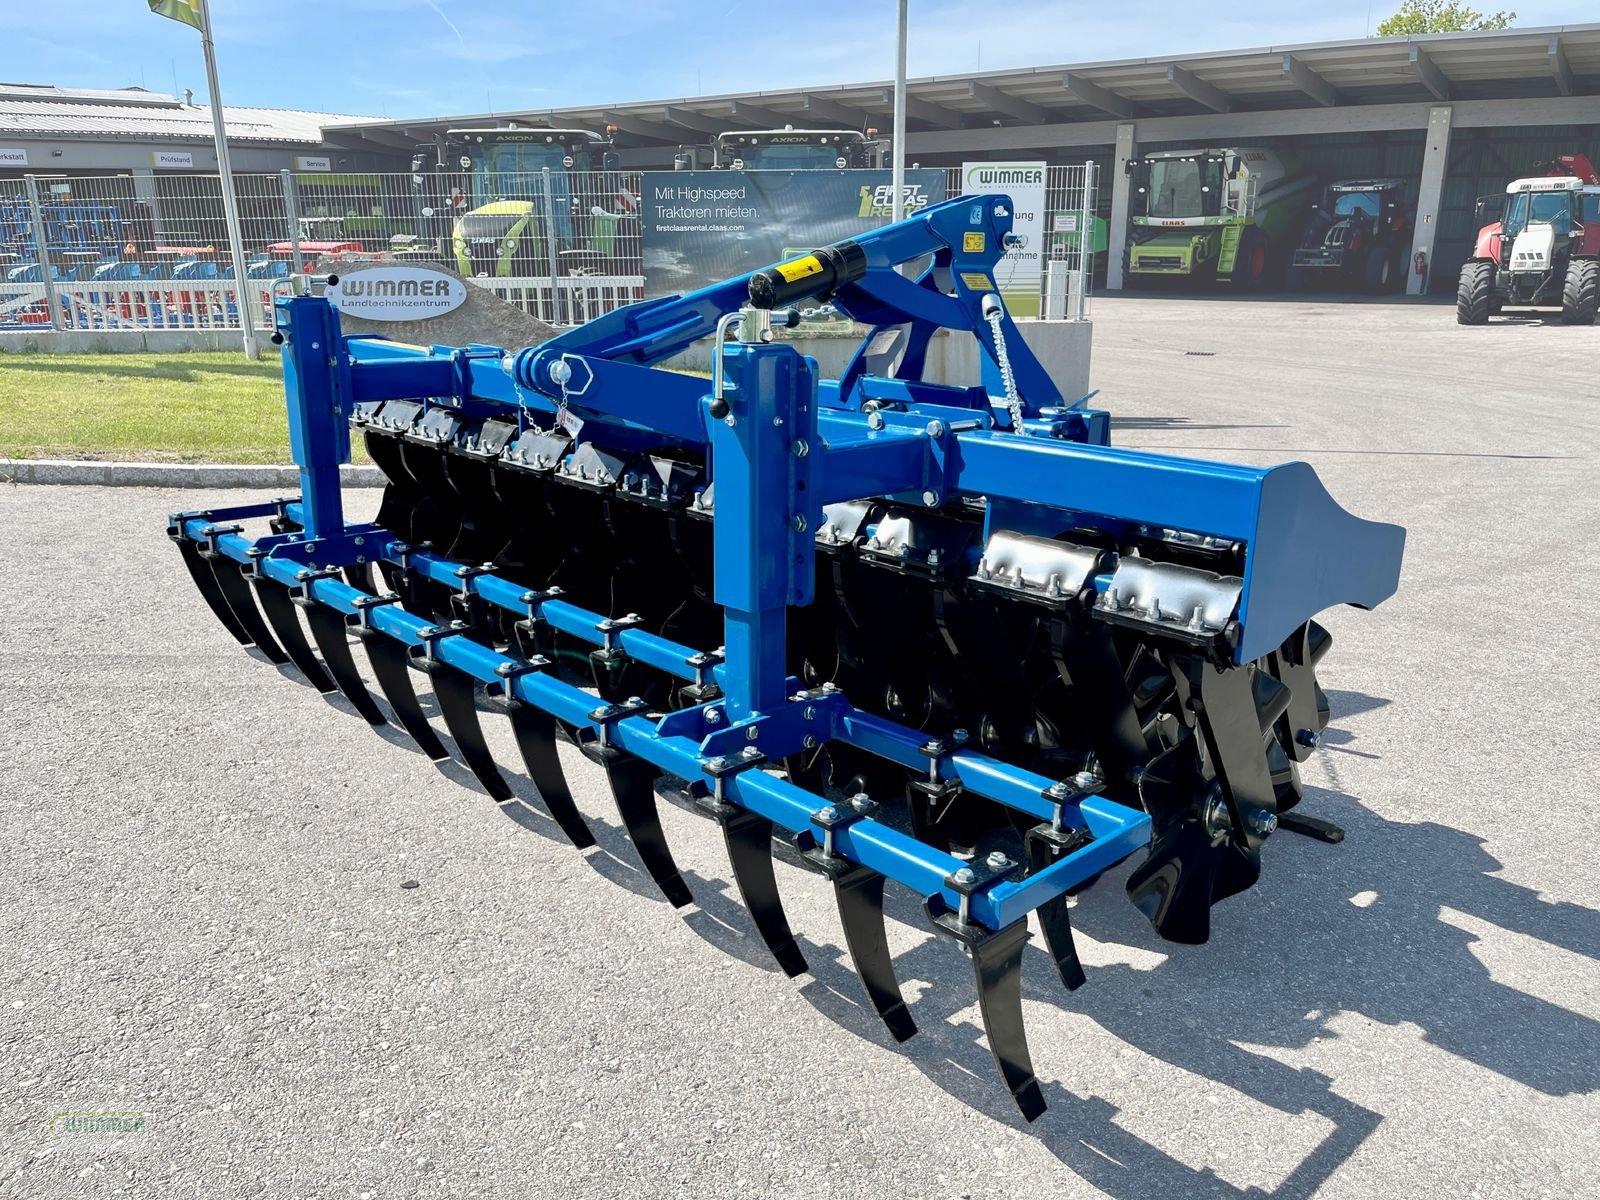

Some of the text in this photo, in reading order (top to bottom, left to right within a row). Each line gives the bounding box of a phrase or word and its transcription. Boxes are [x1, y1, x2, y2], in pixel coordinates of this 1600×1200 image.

[160, 155, 191, 163] Prüfstand
[980, 171, 1042, 183] WIMMER
[655, 186, 746, 203] Mit Highspeed
[873, 195, 929, 206] CLAS
[655, 205, 760, 219] Traktoren mieten.
[656, 224, 745, 232] firstclaasrental.claas.com
[341, 279, 450, 297] WIMMER
[341, 299, 450, 307] Landtechnikzentrum
